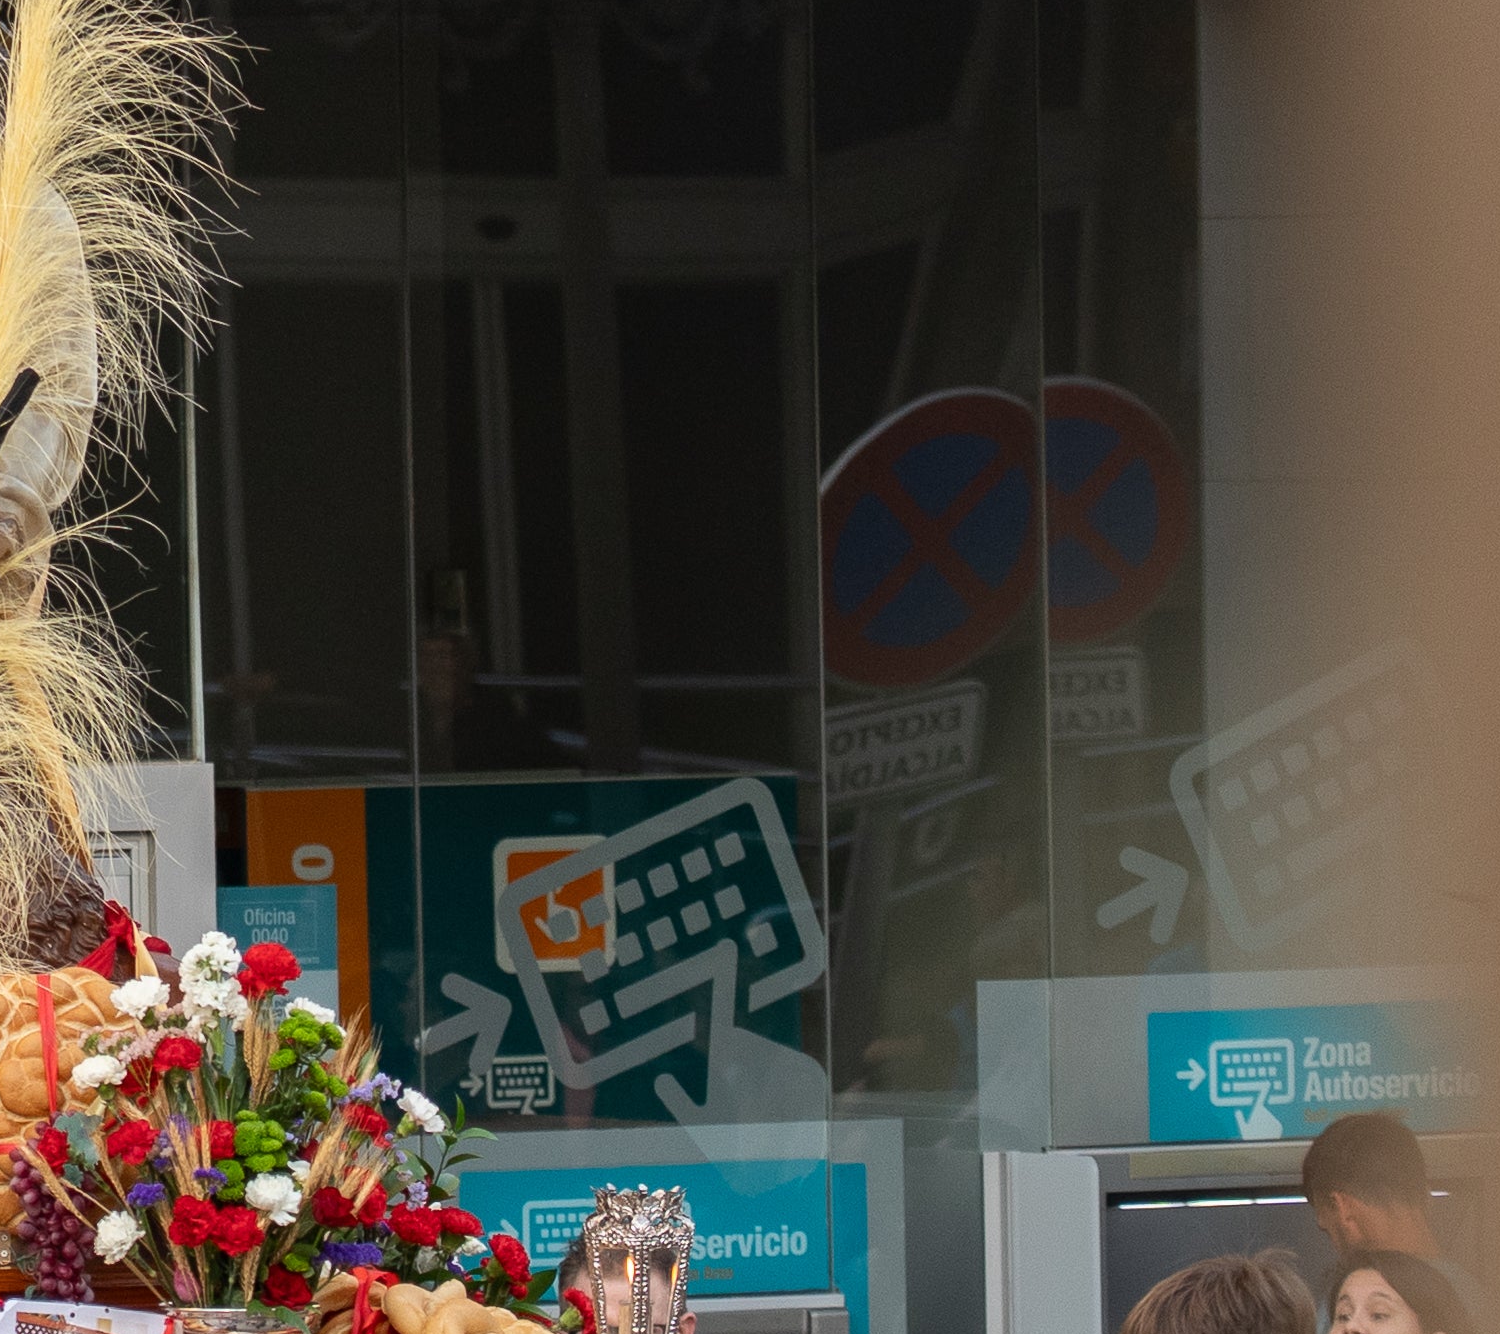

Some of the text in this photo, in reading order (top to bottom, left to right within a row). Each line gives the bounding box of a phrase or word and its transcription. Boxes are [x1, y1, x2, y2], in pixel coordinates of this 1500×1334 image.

[243, 908, 297, 926] Oficina
[1303, 1037, 1372, 1068] Zona
[692, 1226, 808, 1260] servicio
